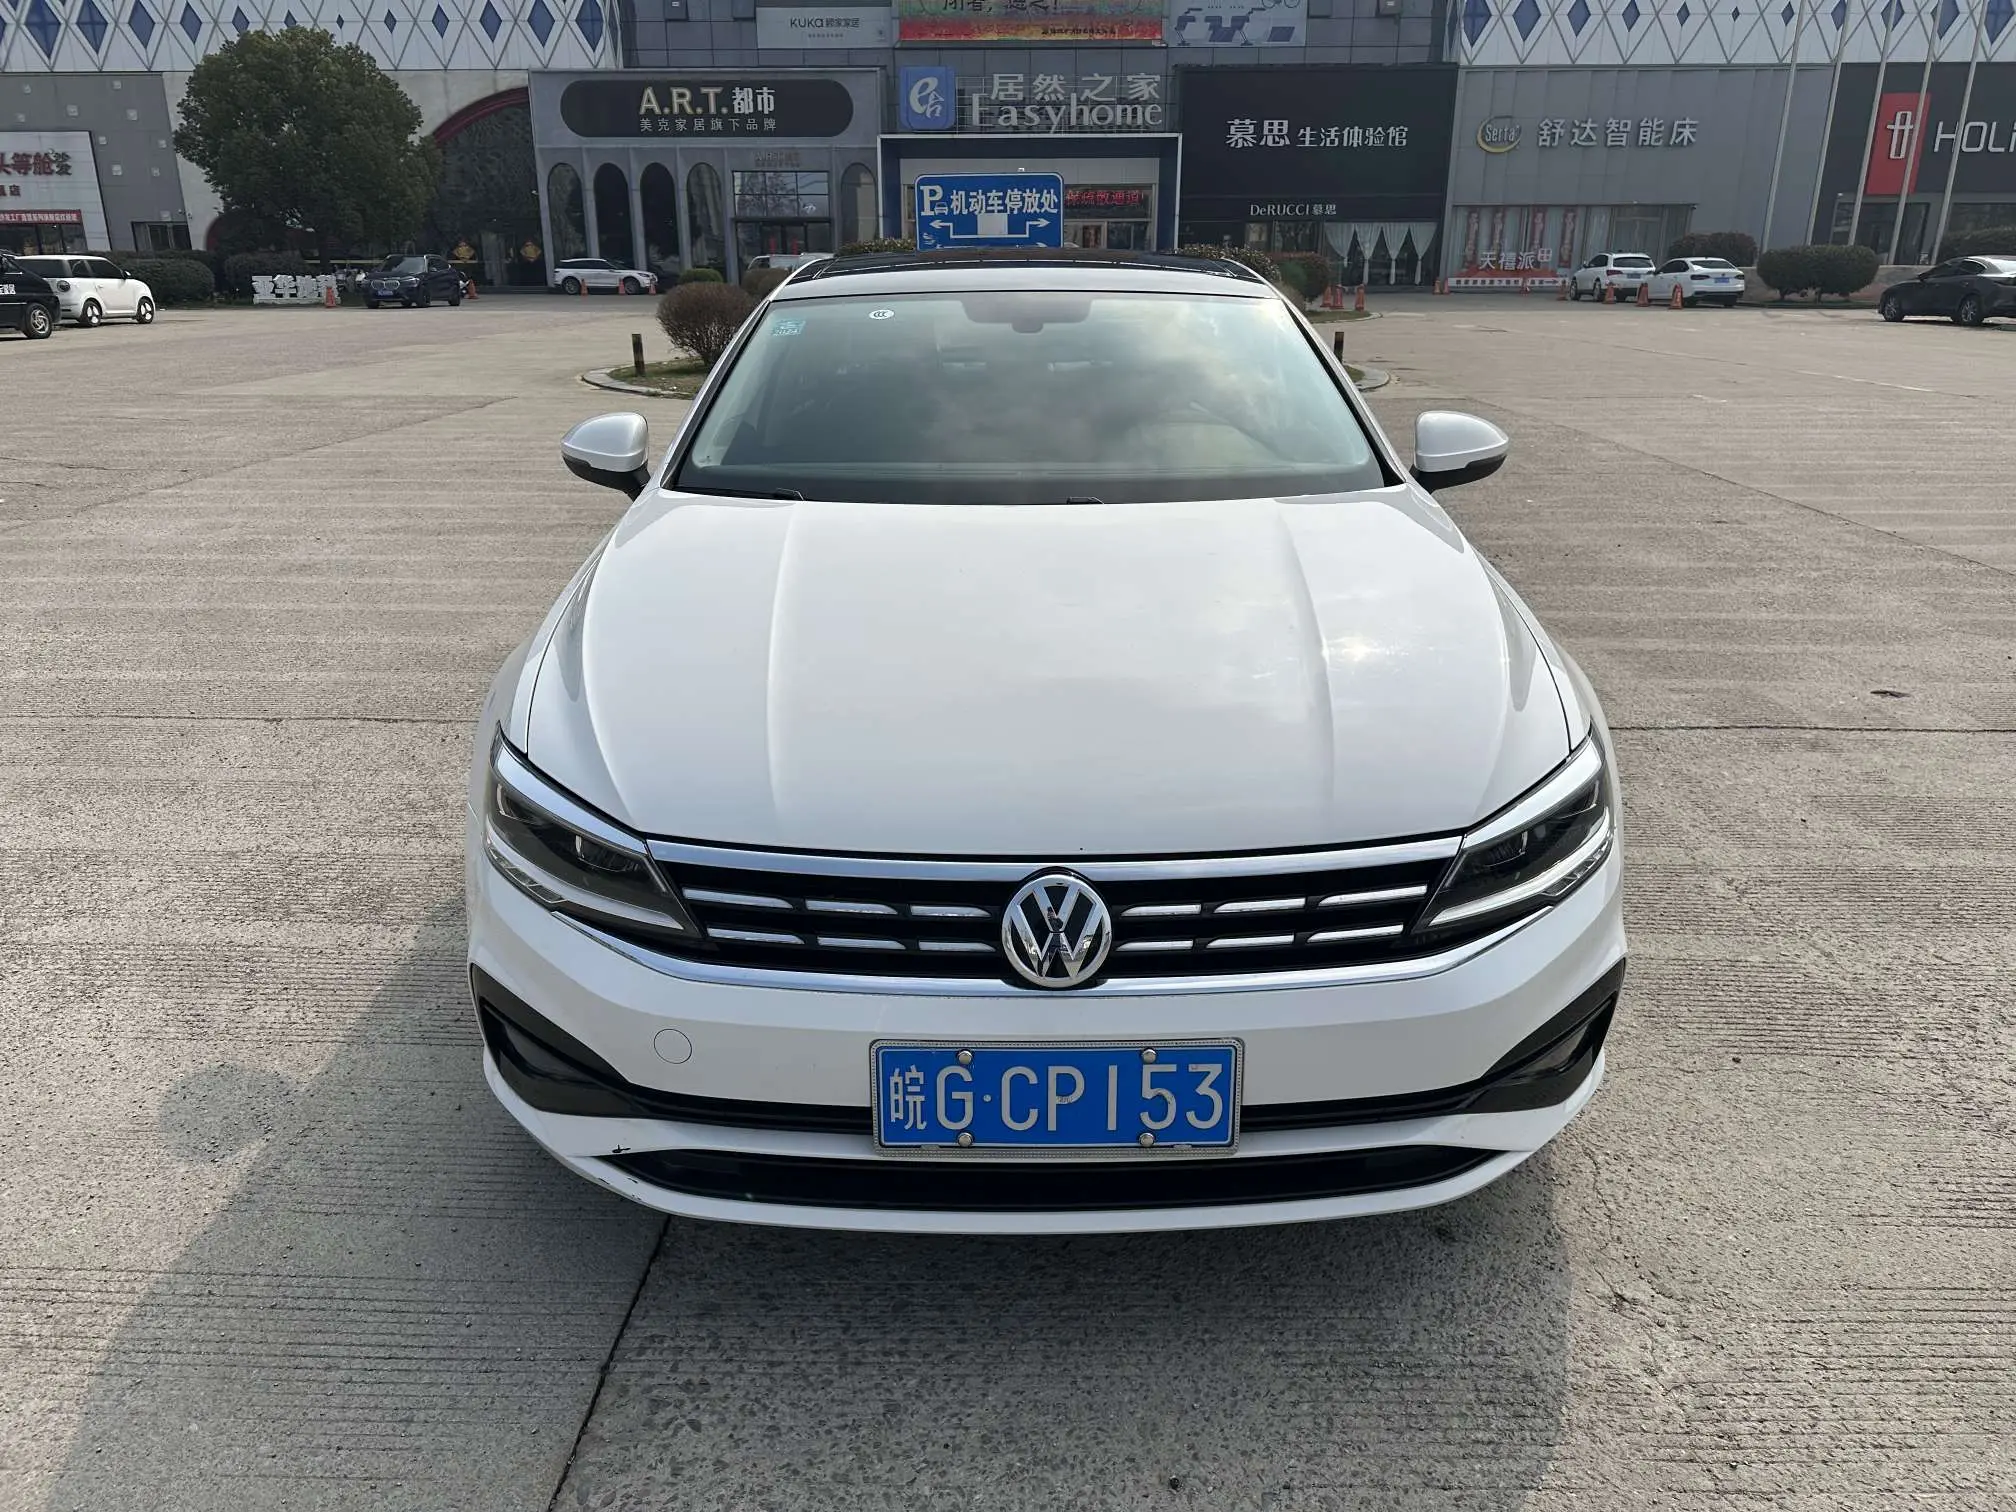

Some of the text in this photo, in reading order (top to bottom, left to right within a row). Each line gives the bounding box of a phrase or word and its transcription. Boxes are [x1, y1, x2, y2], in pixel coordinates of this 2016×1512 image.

[731, 86, 776, 115] 都市
[990, 73, 1162, 102] 居然之家
[639, 117, 777, 132] 美克家居旗下品牌
[971, 92, 1163, 134] Easyhome
[1225, 118, 1409, 148] 慕思 生活体验馆
[1537, 117, 1699, 148] 舒达智能床
[919, 184, 1059, 216] P 机动车停放处
